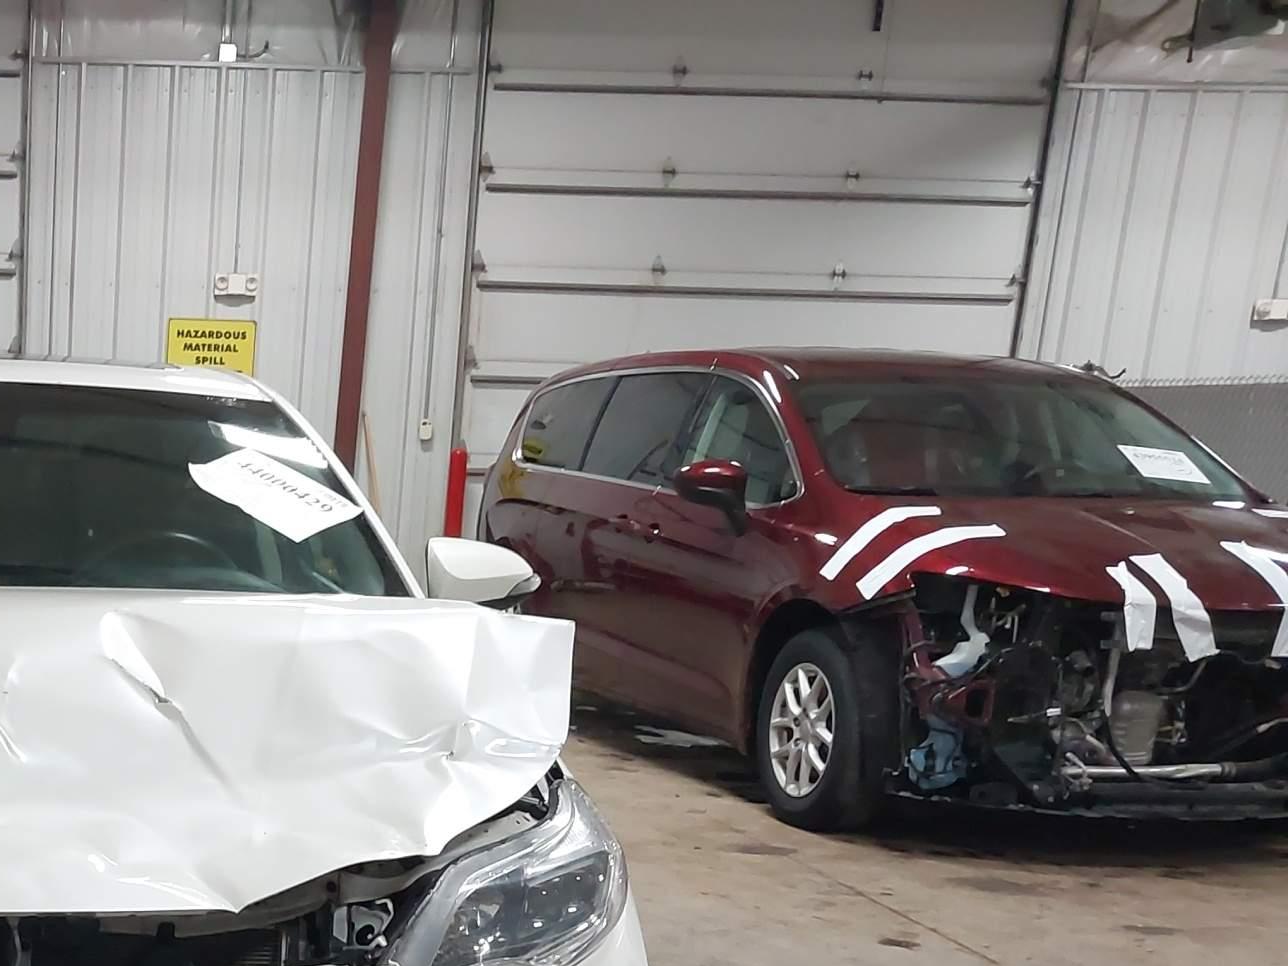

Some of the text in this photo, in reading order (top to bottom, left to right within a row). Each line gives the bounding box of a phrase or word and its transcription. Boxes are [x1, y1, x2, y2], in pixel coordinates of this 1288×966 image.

[176, 329, 247, 340] HAZARDOUS
[183, 342, 239, 353] MATERIAL
[195, 356, 225, 365] SPILL
[237, 462, 333, 512] 44000429
